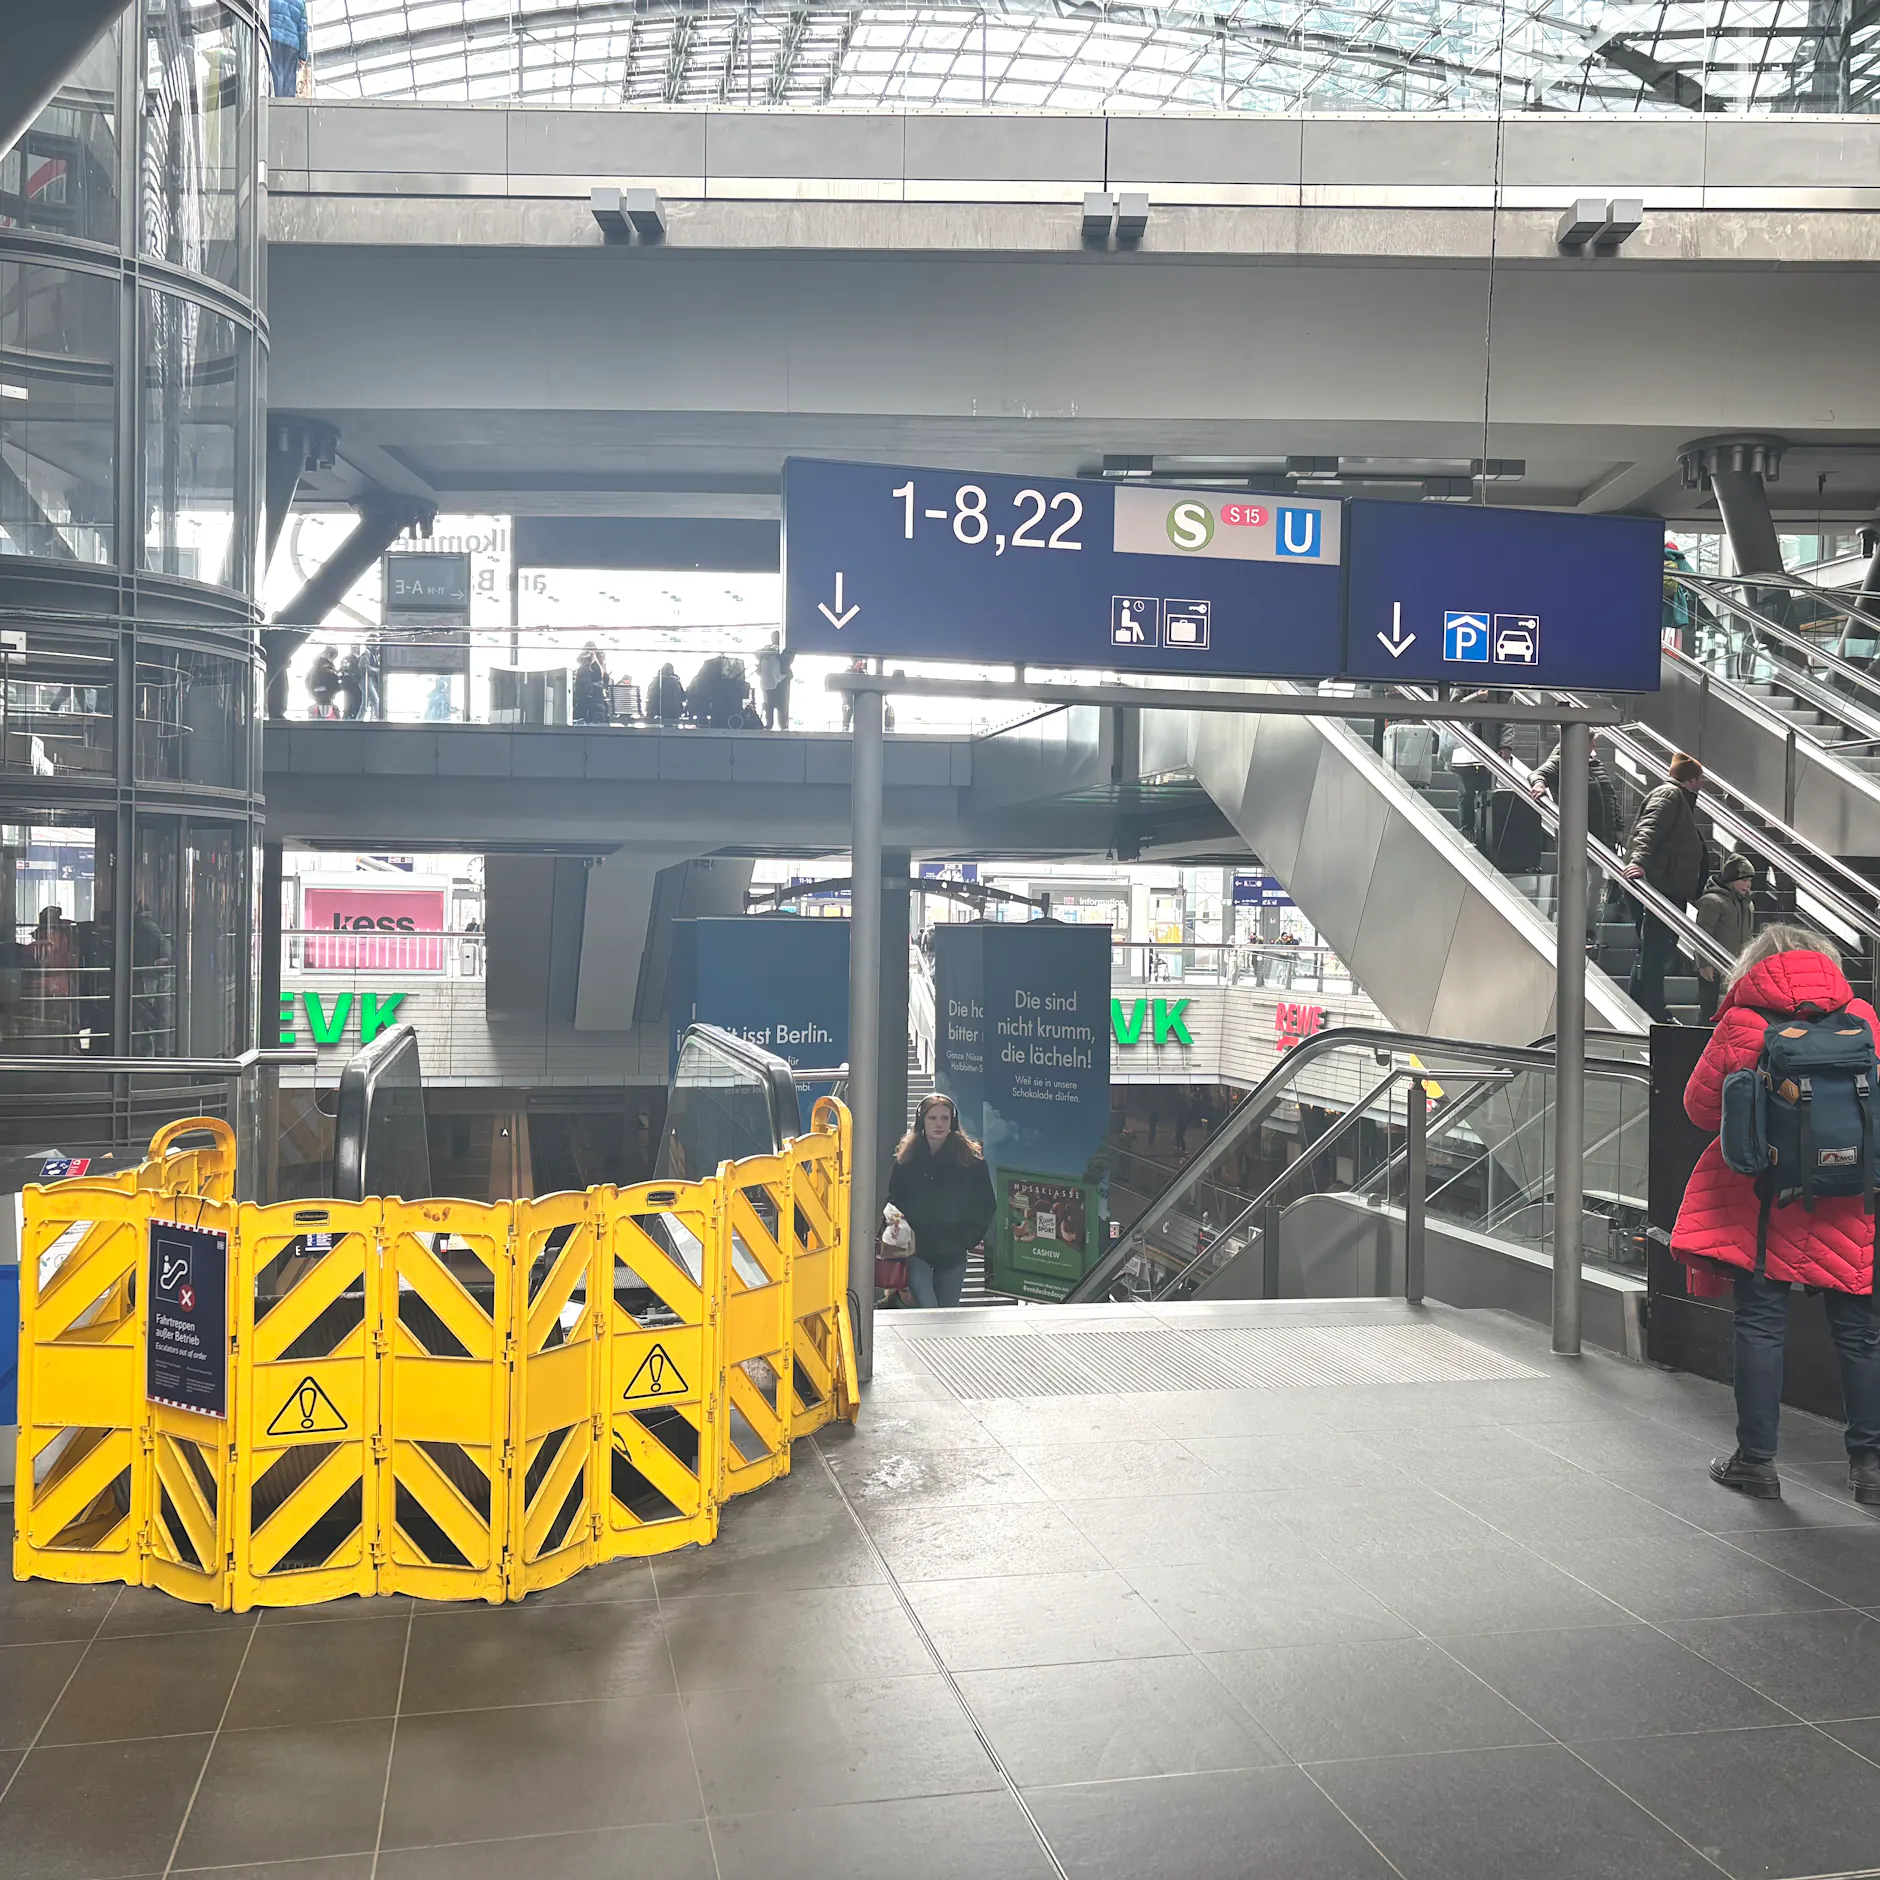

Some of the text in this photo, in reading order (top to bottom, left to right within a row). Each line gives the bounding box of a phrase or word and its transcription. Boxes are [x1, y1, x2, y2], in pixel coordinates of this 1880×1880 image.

[891, 481, 1084, 556] 1-8,22
[1229, 506, 1260, 525] S 15
[1172, 503, 1208, 549] S
[1284, 511, 1314, 554] U
[949, 1000, 969, 1017] Die
[1015, 989, 1077, 1012] Die sind
[1274, 1002, 1323, 1035] REWE
[743, 1026, 772, 1045] isst
[776, 1022, 833, 1044] Berlin.
[948, 1022, 979, 1042] bitter
[997, 1016, 1034, 1037] nicht
[1037, 1017, 1096, 1044] krumm,
[787, 1055, 800, 1067] für
[1001, 1042, 1092, 1069] die lächeln!
[1015, 1074, 1078, 1089] Weil sie in unsere
[1012, 1087, 1053, 1100] Schokolade
[1013, 1183, 1080, 1200] NUSSKLASSE
[1038, 1225, 1055, 1234] SPORT
[1032, 1247, 1061, 1259] CASHEW
[155, 1313, 196, 1332] Fahrtreppen
[155, 1328, 200, 1346] außer Betrieb
[155, 1342, 208, 1361] Escalators out of order
